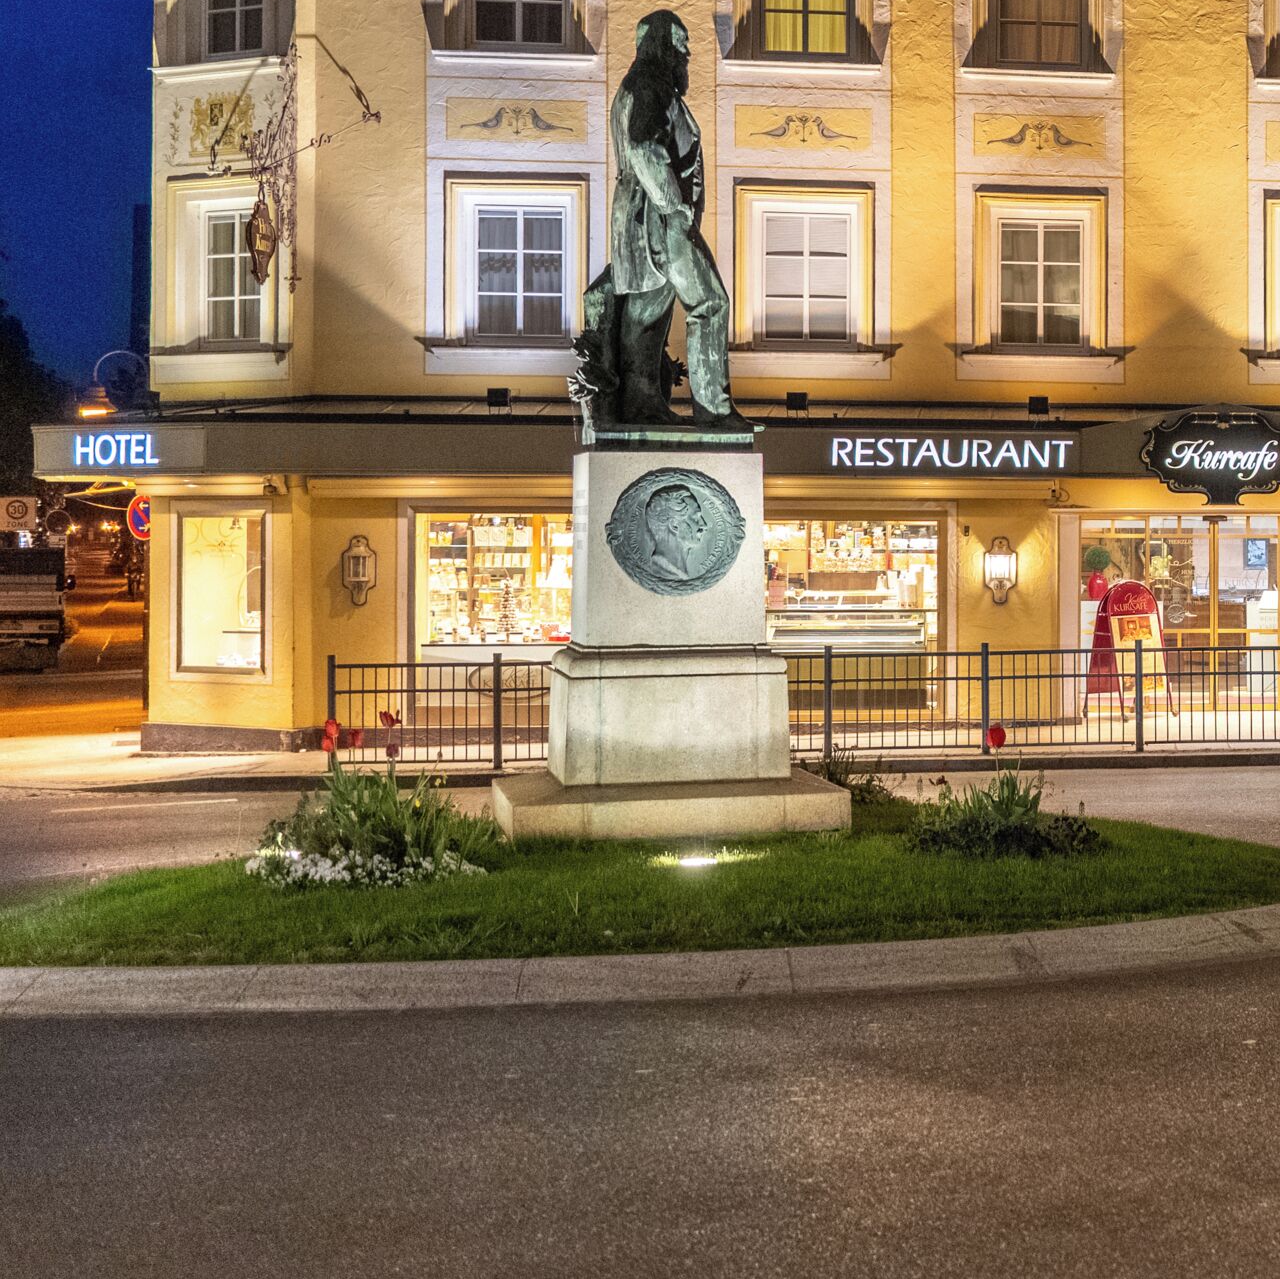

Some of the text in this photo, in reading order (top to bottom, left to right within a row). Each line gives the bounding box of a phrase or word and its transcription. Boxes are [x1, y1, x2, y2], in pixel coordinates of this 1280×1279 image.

[75, 434, 160, 466] HOTEL
[831, 437, 1074, 468] RESTAURANT
[1165, 439, 1280, 481] Kurcafe
[6, 521, 29, 529] ZONE
[10, 504, 24, 516] 30
